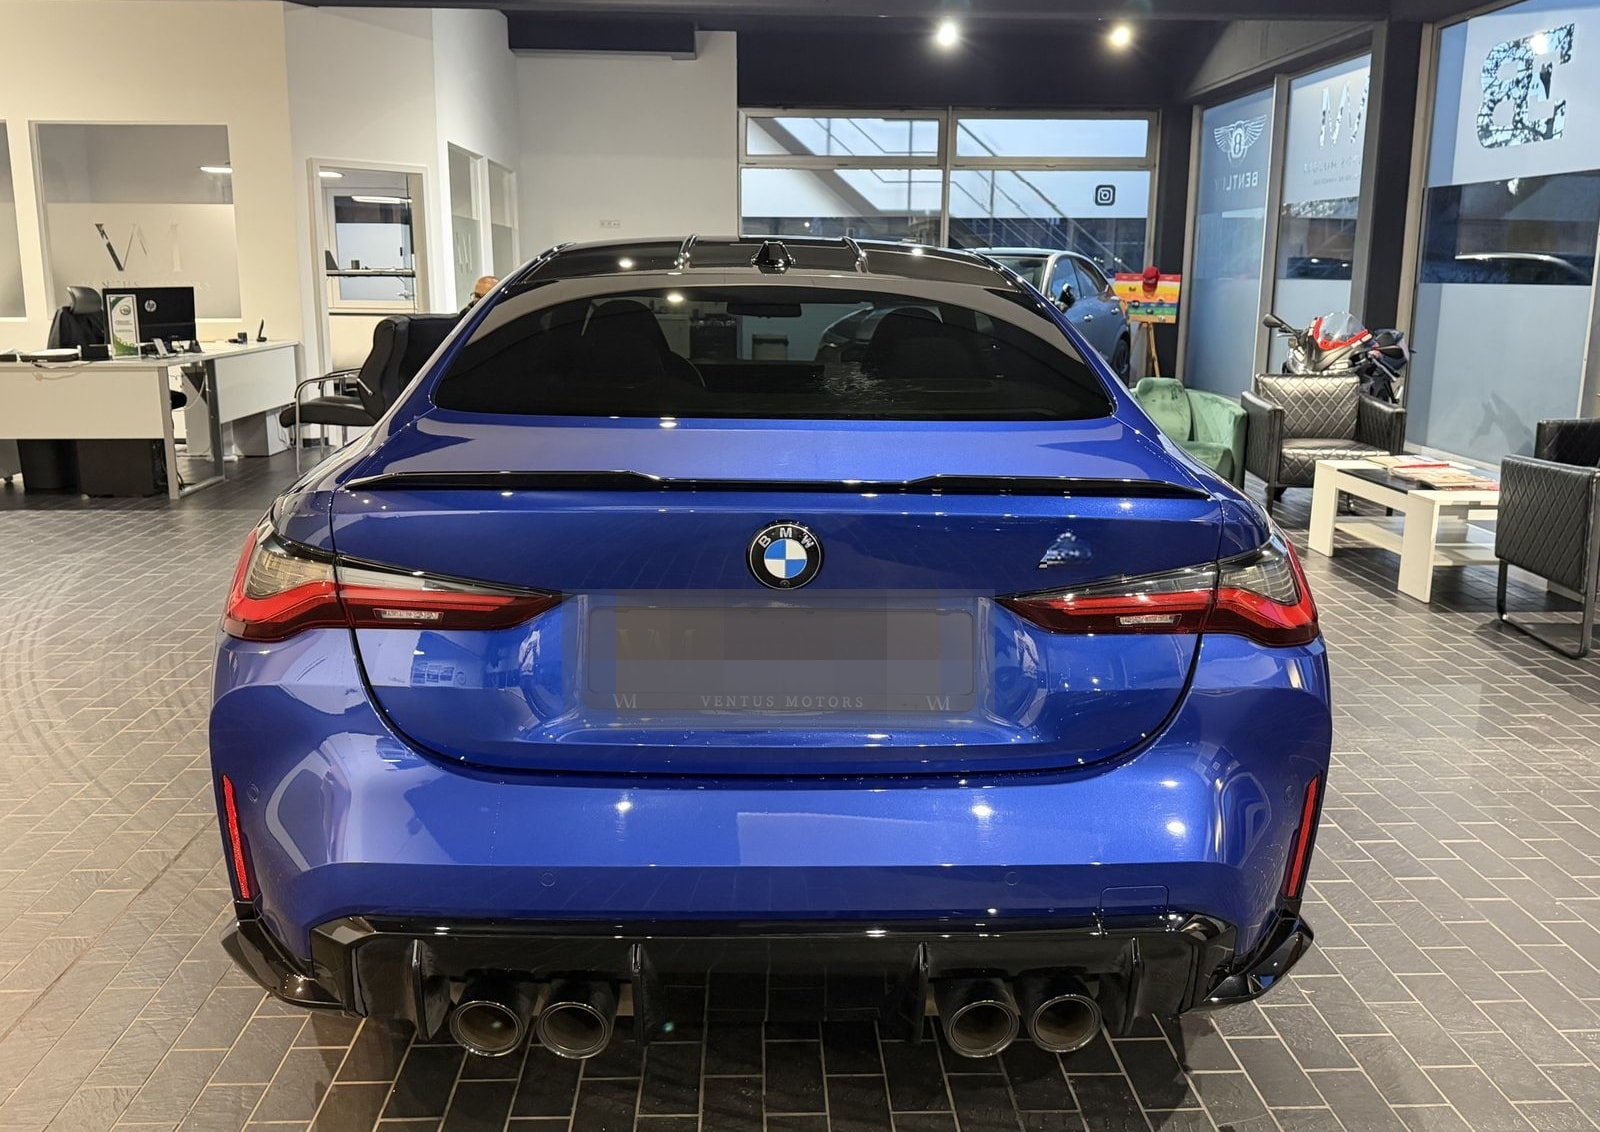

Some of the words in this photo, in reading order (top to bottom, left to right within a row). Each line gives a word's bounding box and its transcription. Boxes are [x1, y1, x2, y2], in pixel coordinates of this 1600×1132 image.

[758, 527, 815, 549] BMW
[701, 695, 775, 707] VENTUS
[786, 695, 864, 708] MOTORS
